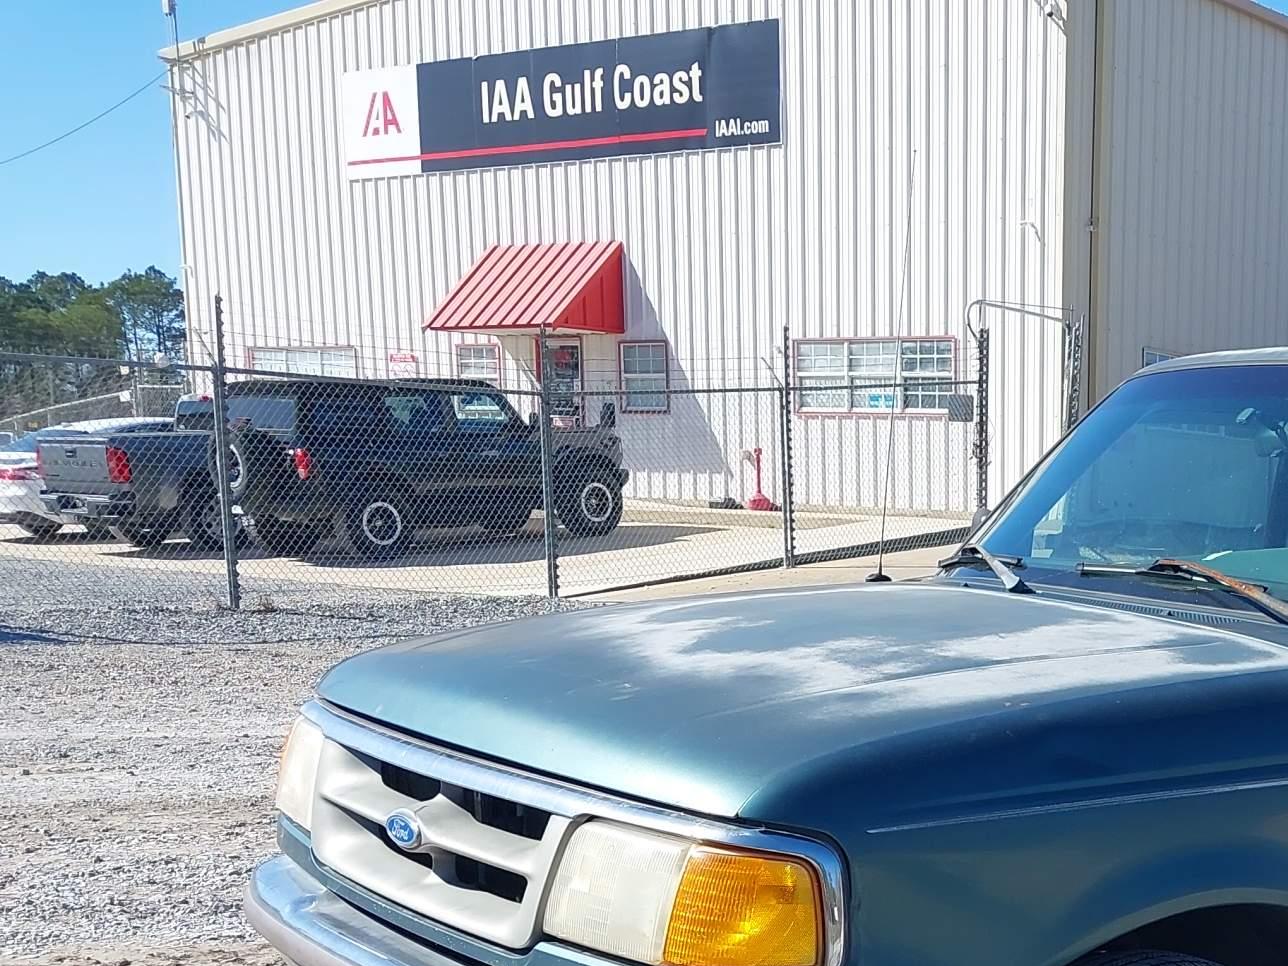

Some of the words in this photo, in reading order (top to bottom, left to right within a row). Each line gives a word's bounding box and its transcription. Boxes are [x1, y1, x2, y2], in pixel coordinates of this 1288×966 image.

[481, 76, 535, 124] IAA
[542, 67, 604, 118] Gulf
[613, 61, 704, 110] Coast
[715, 117, 769, 138] IAAI.com
[391, 818, 411, 841] Ford
